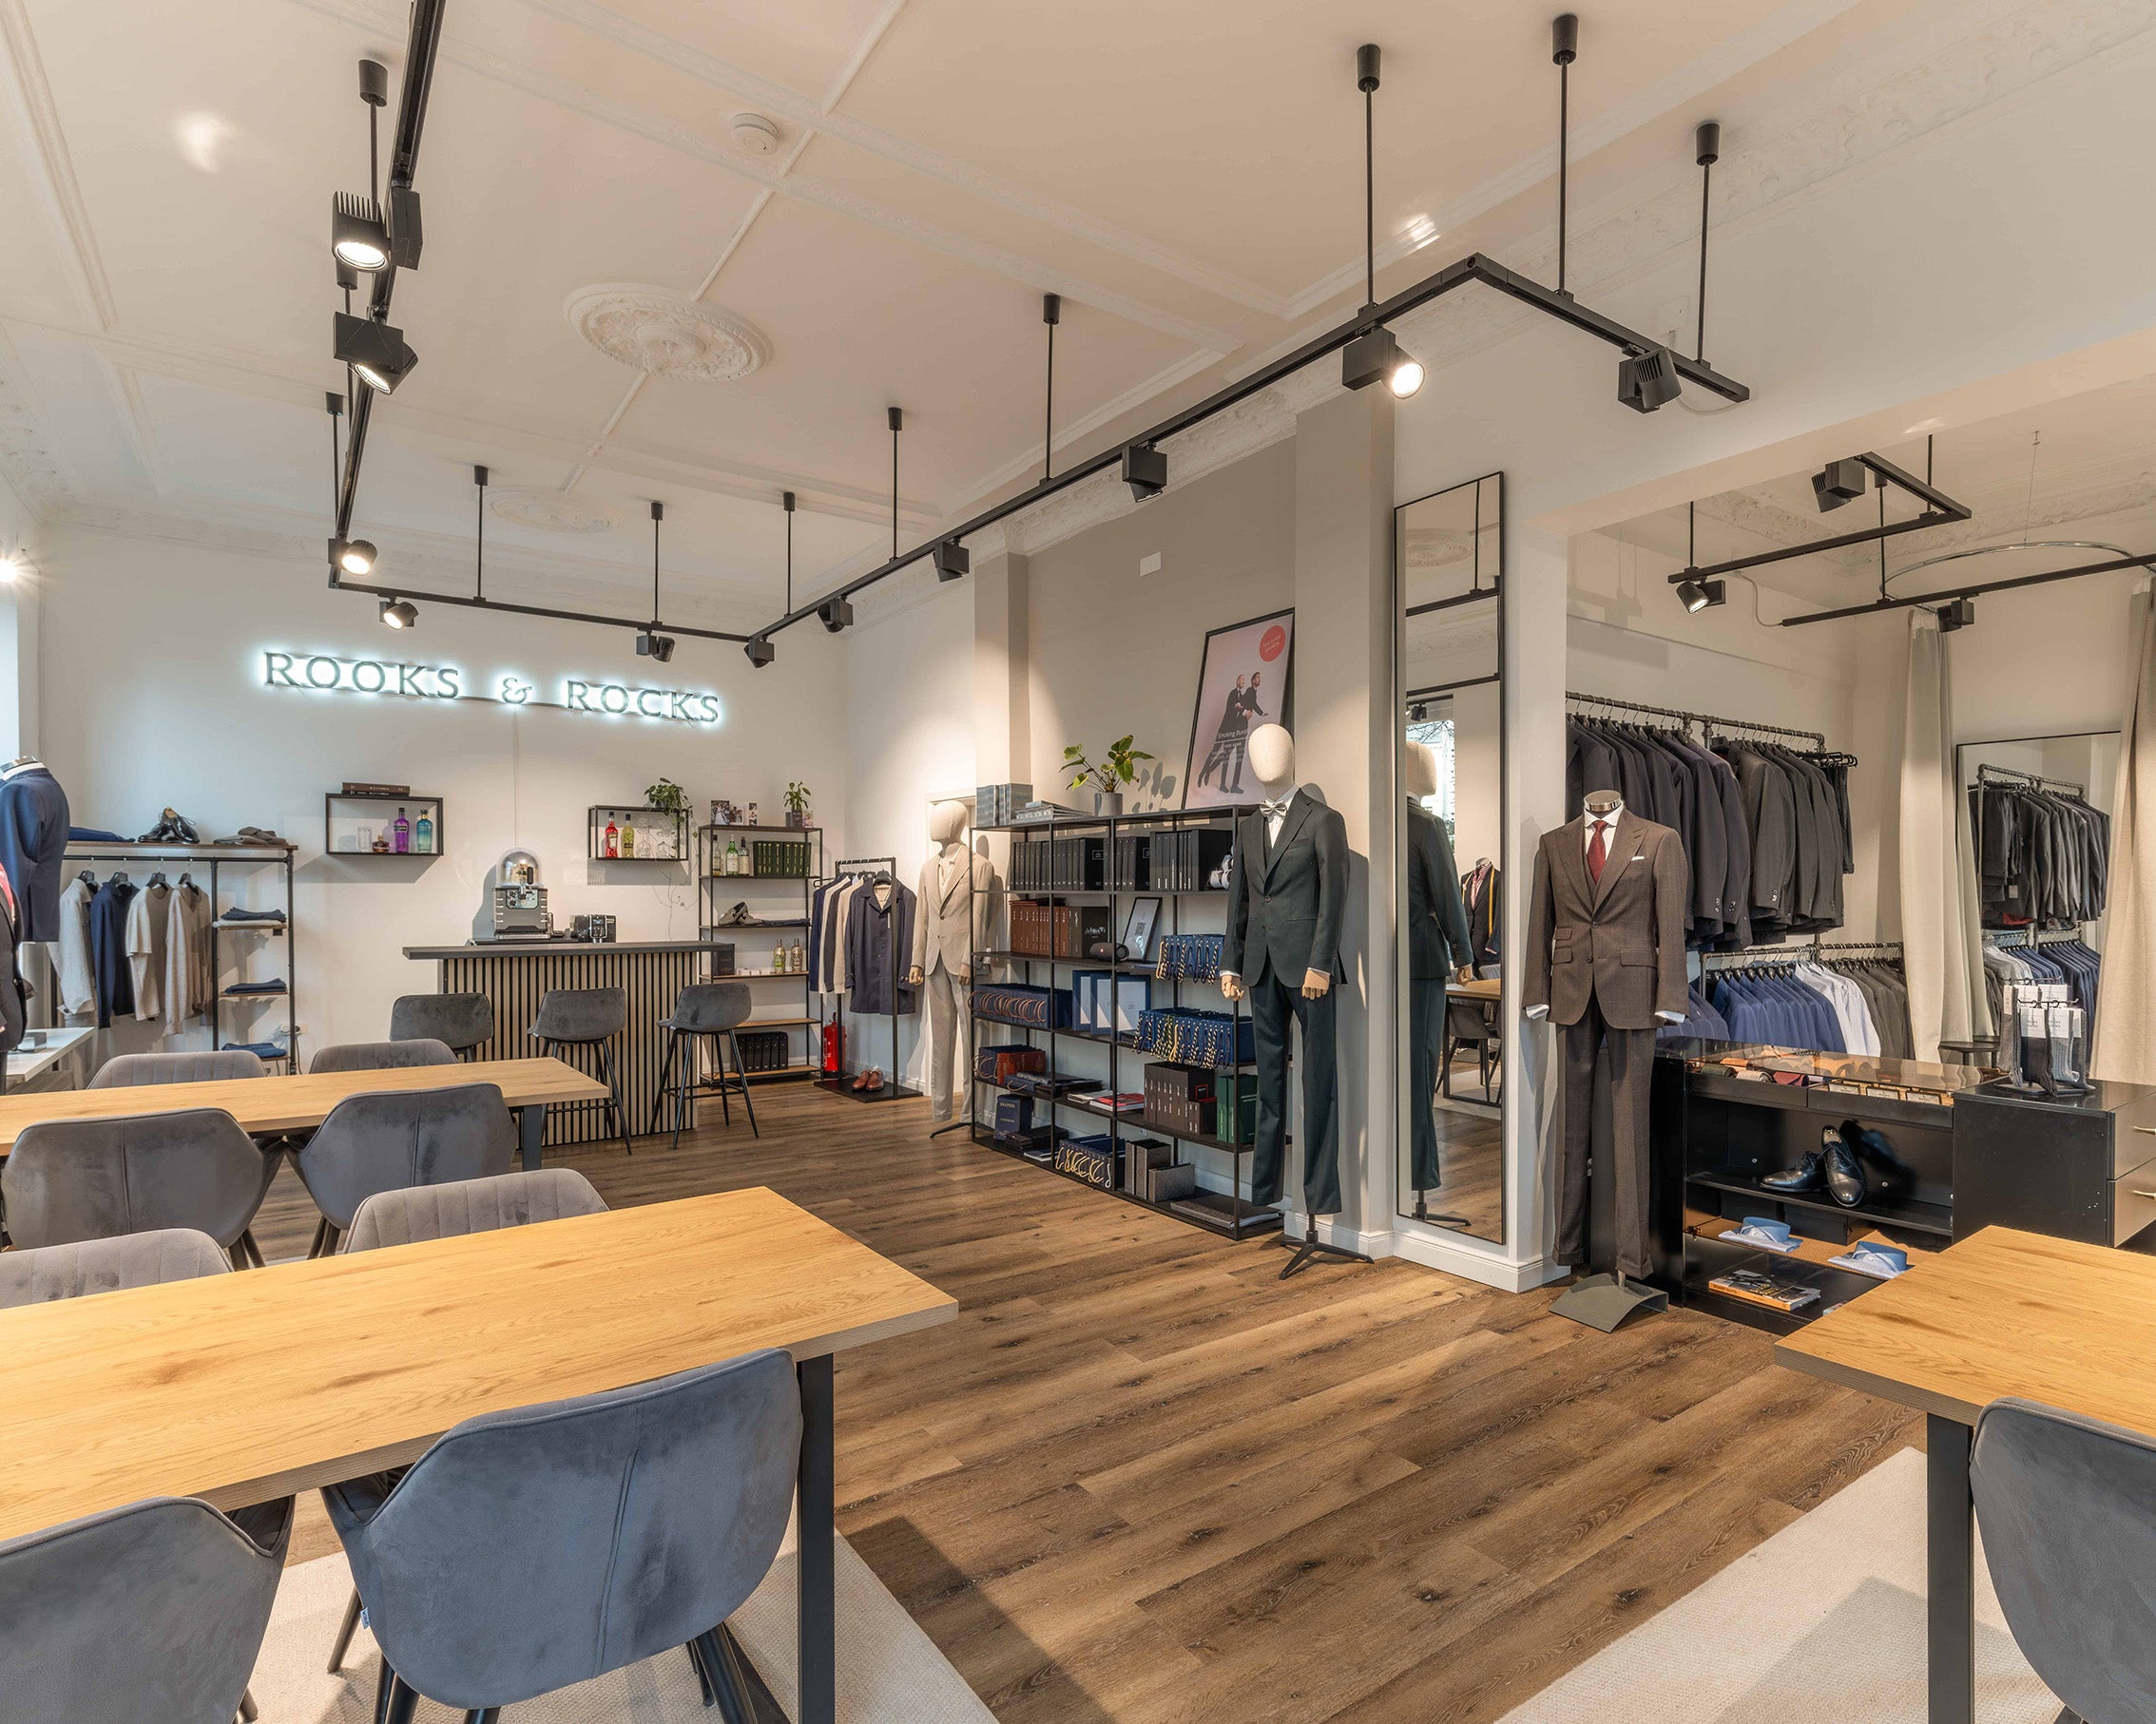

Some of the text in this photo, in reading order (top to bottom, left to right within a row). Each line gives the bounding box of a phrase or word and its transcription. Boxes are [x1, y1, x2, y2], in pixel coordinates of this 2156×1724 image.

[266, 652, 720, 723] ROOKS & ROCKS
